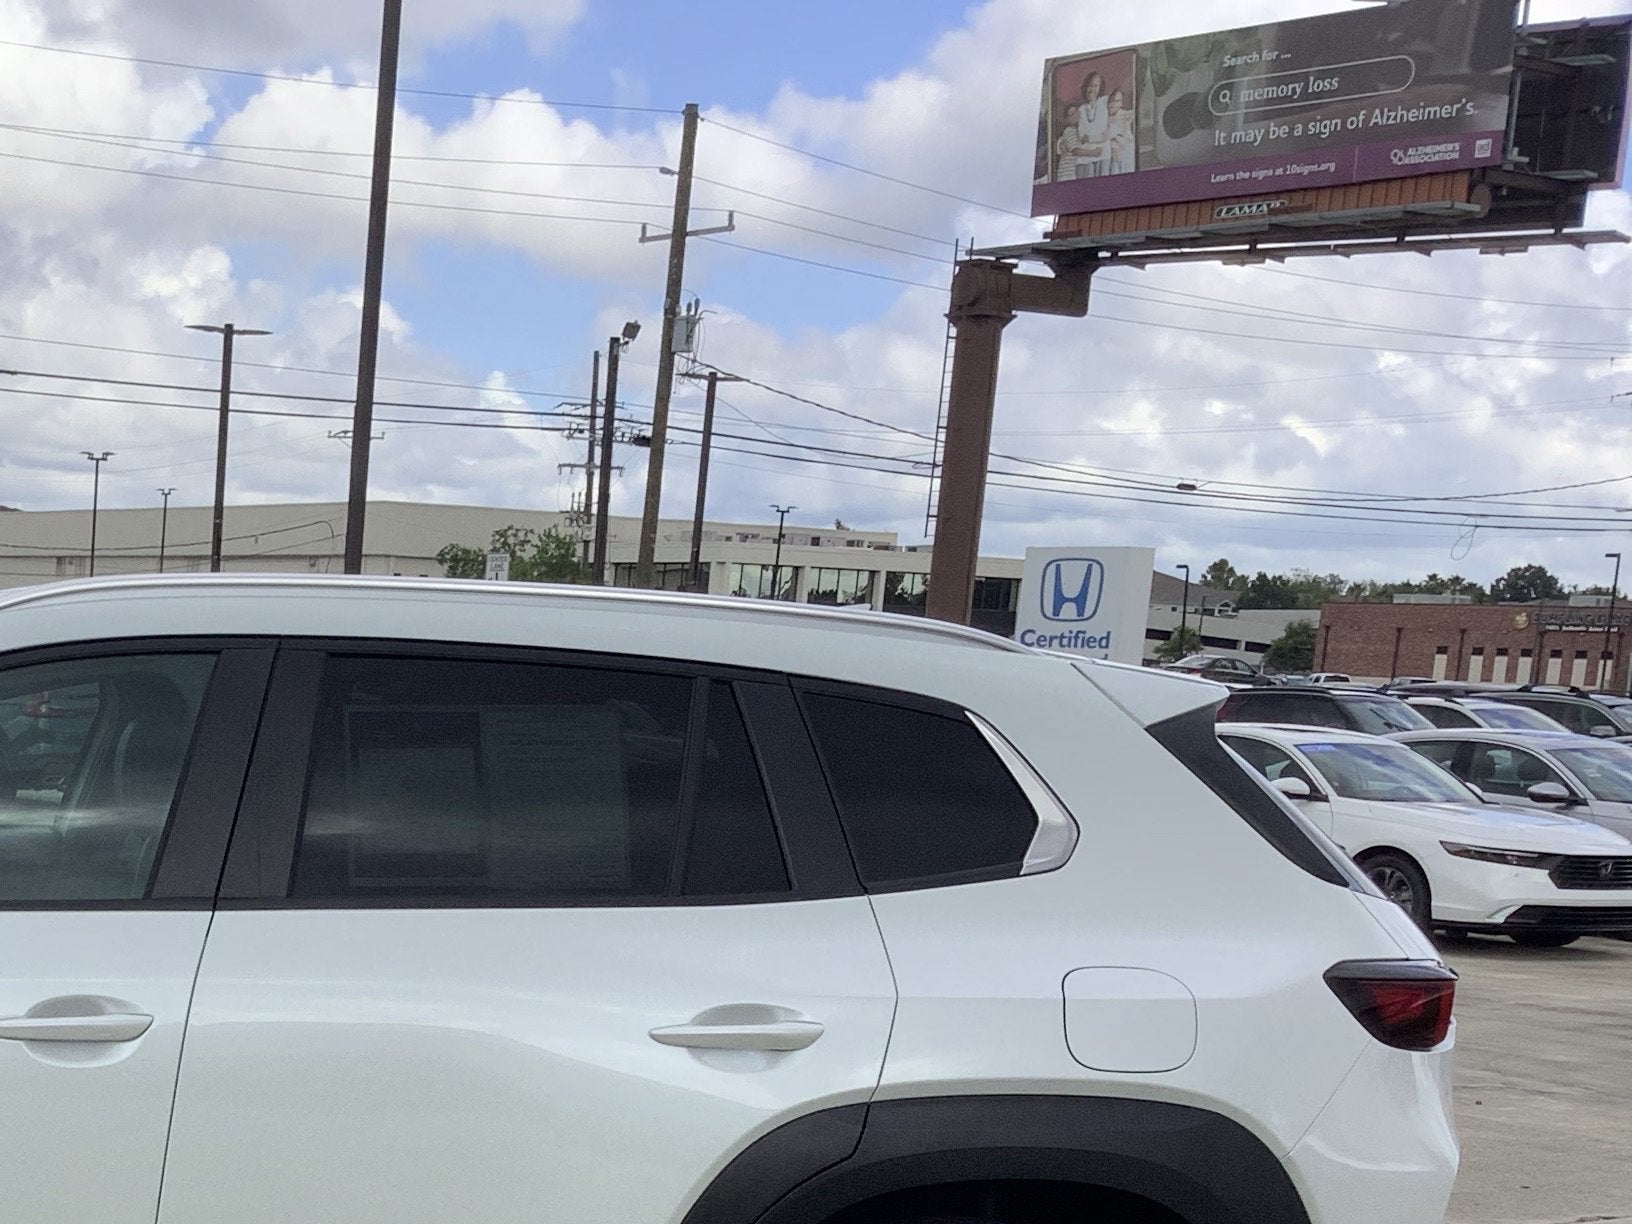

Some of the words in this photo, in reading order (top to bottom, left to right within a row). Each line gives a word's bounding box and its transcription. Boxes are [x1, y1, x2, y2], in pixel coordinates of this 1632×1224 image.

[1223, 51, 1259, 68] Search
[1262, 49, 1279, 62] for
[1240, 77, 1304, 102] memory
[1308, 75, 1340, 93] loss
[1214, 129, 1227, 146] It
[1230, 126, 1265, 146] may
[1269, 121, 1289, 139] be
[1293, 124, 1303, 137] a
[1307, 115, 1342, 138] sign
[1346, 110, 1368, 130] of
[1210, 173, 1235, 183] Learn
[1236, 170, 1250, 180] the
[1020, 628, 1112, 650] Certified
